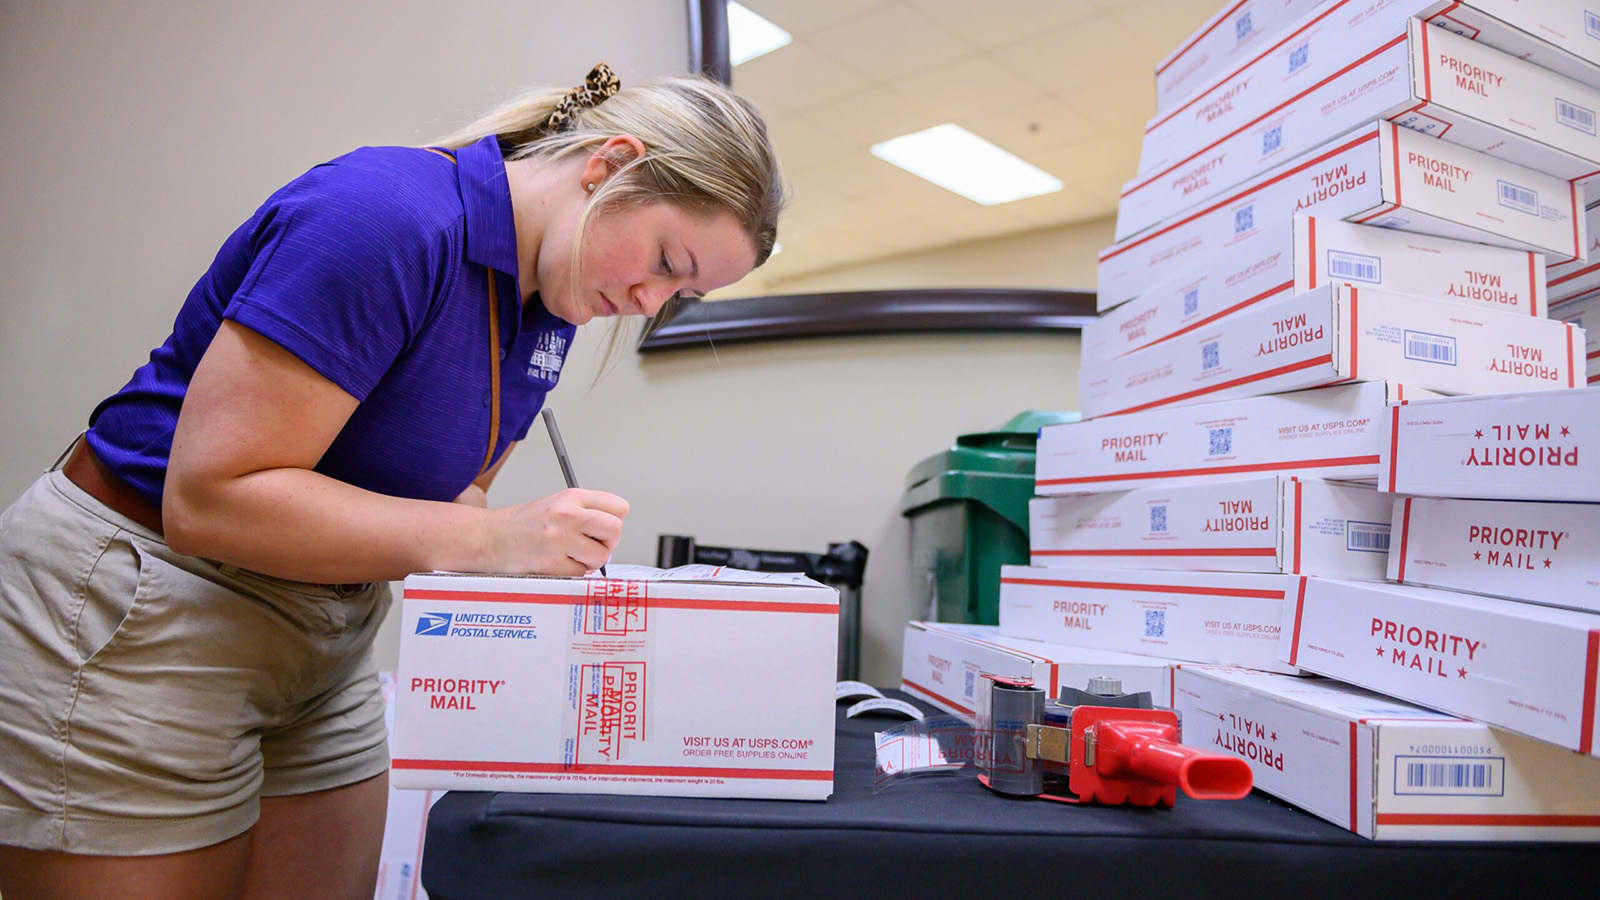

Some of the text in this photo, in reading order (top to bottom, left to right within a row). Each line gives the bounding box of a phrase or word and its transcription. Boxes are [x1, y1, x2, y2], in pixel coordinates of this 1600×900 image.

[1456, 75, 1488, 97] MAIL
[1196, 79, 1250, 120] PRIORITY
[1321, 100, 1336, 112] VISIT
[1338, 94, 1347, 103] US
[1348, 88, 1356, 97] AT
[1206, 102, 1234, 124] MAIL
[1172, 154, 1224, 190] PRIORITY
[1312, 164, 1348, 188] MAIL
[1182, 176, 1210, 197] MAIL
[1294, 171, 1366, 212] PRIORITY
[1423, 172, 1456, 193] MAIL
[1465, 270, 1501, 287] MAIL
[1119, 306, 1158, 334] PRIORITY
[1272, 313, 1306, 334] MAIL
[1127, 326, 1147, 343] MAIL
[1507, 344, 1542, 362] MAIL
[1278, 426, 1296, 434] VISIT
[1492, 424, 1550, 441] MAIL
[1114, 450, 1147, 463] MAIL
[1219, 501, 1251, 513] MAIL
[1487, 551, 1535, 570] MAIL
[455, 614, 532, 624] UNITED STATES
[1064, 616, 1092, 630] MAIL
[451, 628, 489, 638] POSTAL
[928, 654, 951, 672] PRIORITY
[1392, 650, 1448, 678] MAIL
[931, 671, 943, 685] MAIL
[430, 696, 476, 710] MAIL
[584, 694, 598, 735] MAIL
[1230, 713, 1265, 739] MAIL
[683, 737, 710, 746] VISIT
[714, 738, 730, 747] US
[732, 738, 745, 748] AT
[683, 749, 711, 757] ORDER
[736, 750, 776, 758] SUPPLIES
[779, 752, 808, 760] ONLINE
